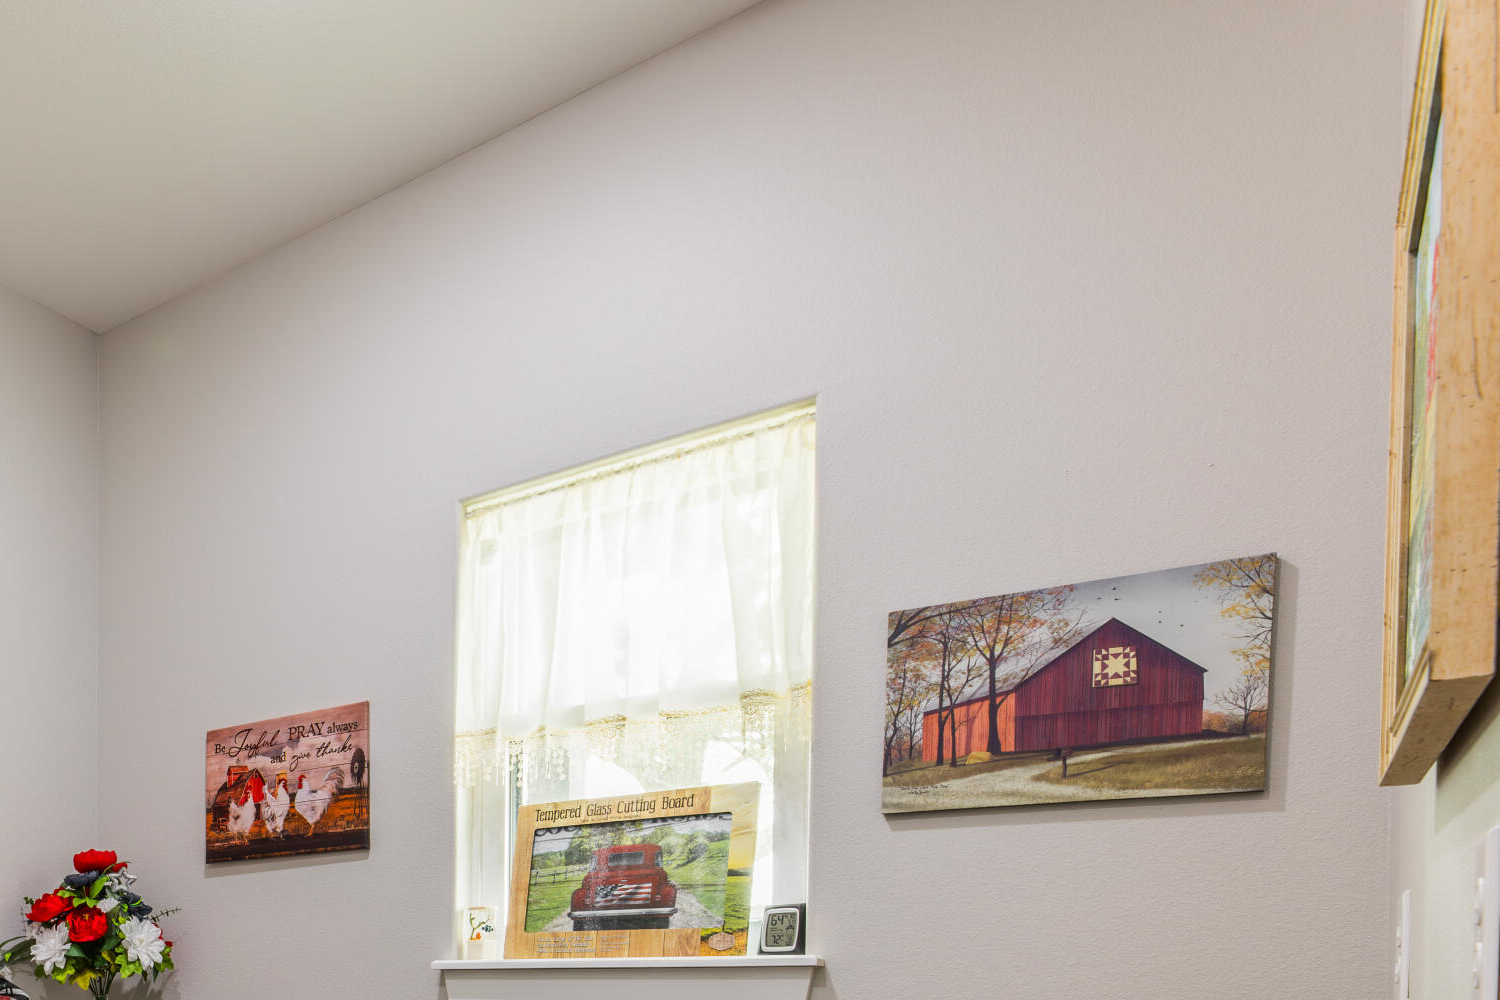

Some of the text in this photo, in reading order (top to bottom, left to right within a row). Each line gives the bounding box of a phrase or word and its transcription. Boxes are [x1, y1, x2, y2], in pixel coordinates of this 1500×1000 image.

[214, 721, 359, 757] Be Joyful PRAY always
[270, 734, 352, 771] and give thanks
[535, 794, 694, 823] Tempered Glass Cutting Board
[771, 915, 784, 926] 64
